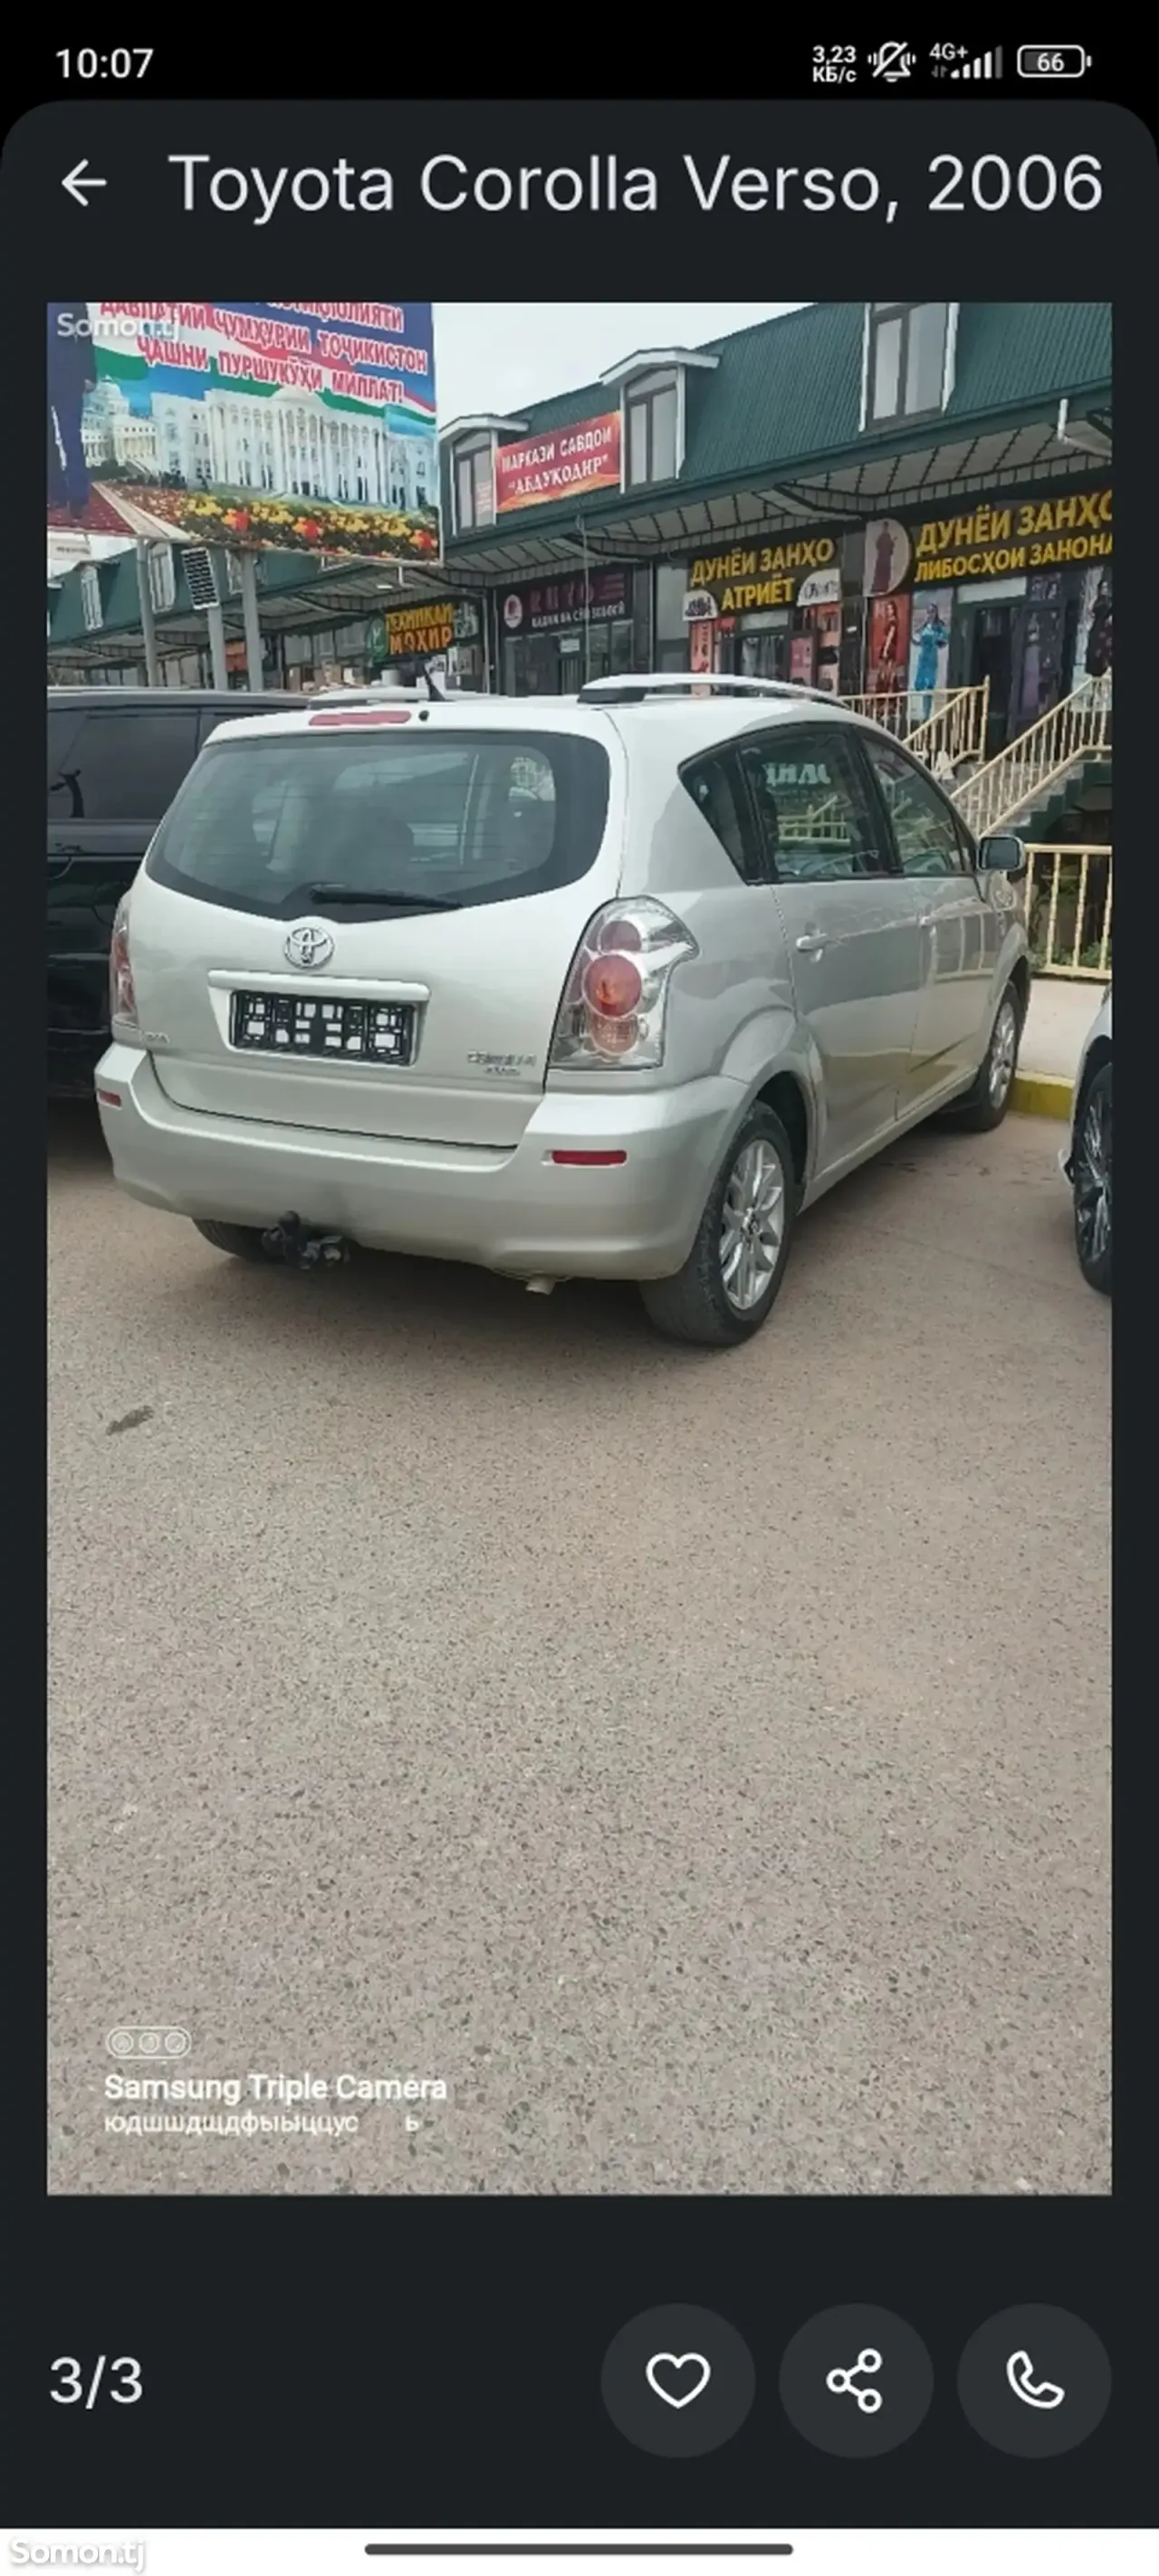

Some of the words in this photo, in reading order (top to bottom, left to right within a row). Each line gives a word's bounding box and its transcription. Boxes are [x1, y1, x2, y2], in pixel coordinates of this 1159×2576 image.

[55, 48, 154, 80] 10:07
[812, 45, 857, 65] 3,23
[929, 43, 969, 61] 4G+
[1037, 52, 1065, 72] 66
[812, 66, 857, 84] КБ/с
[168, 155, 393, 225] Toyota
[420, 153, 657, 212] Corolla
[683, 154, 898, 224] Verso,
[927, 154, 1103, 211] 2006
[916, 504, 1011, 558] ДУНЁИ
[690, 547, 756, 587] ДУНЁИ
[50, 2354, 143, 2409] 3/3
